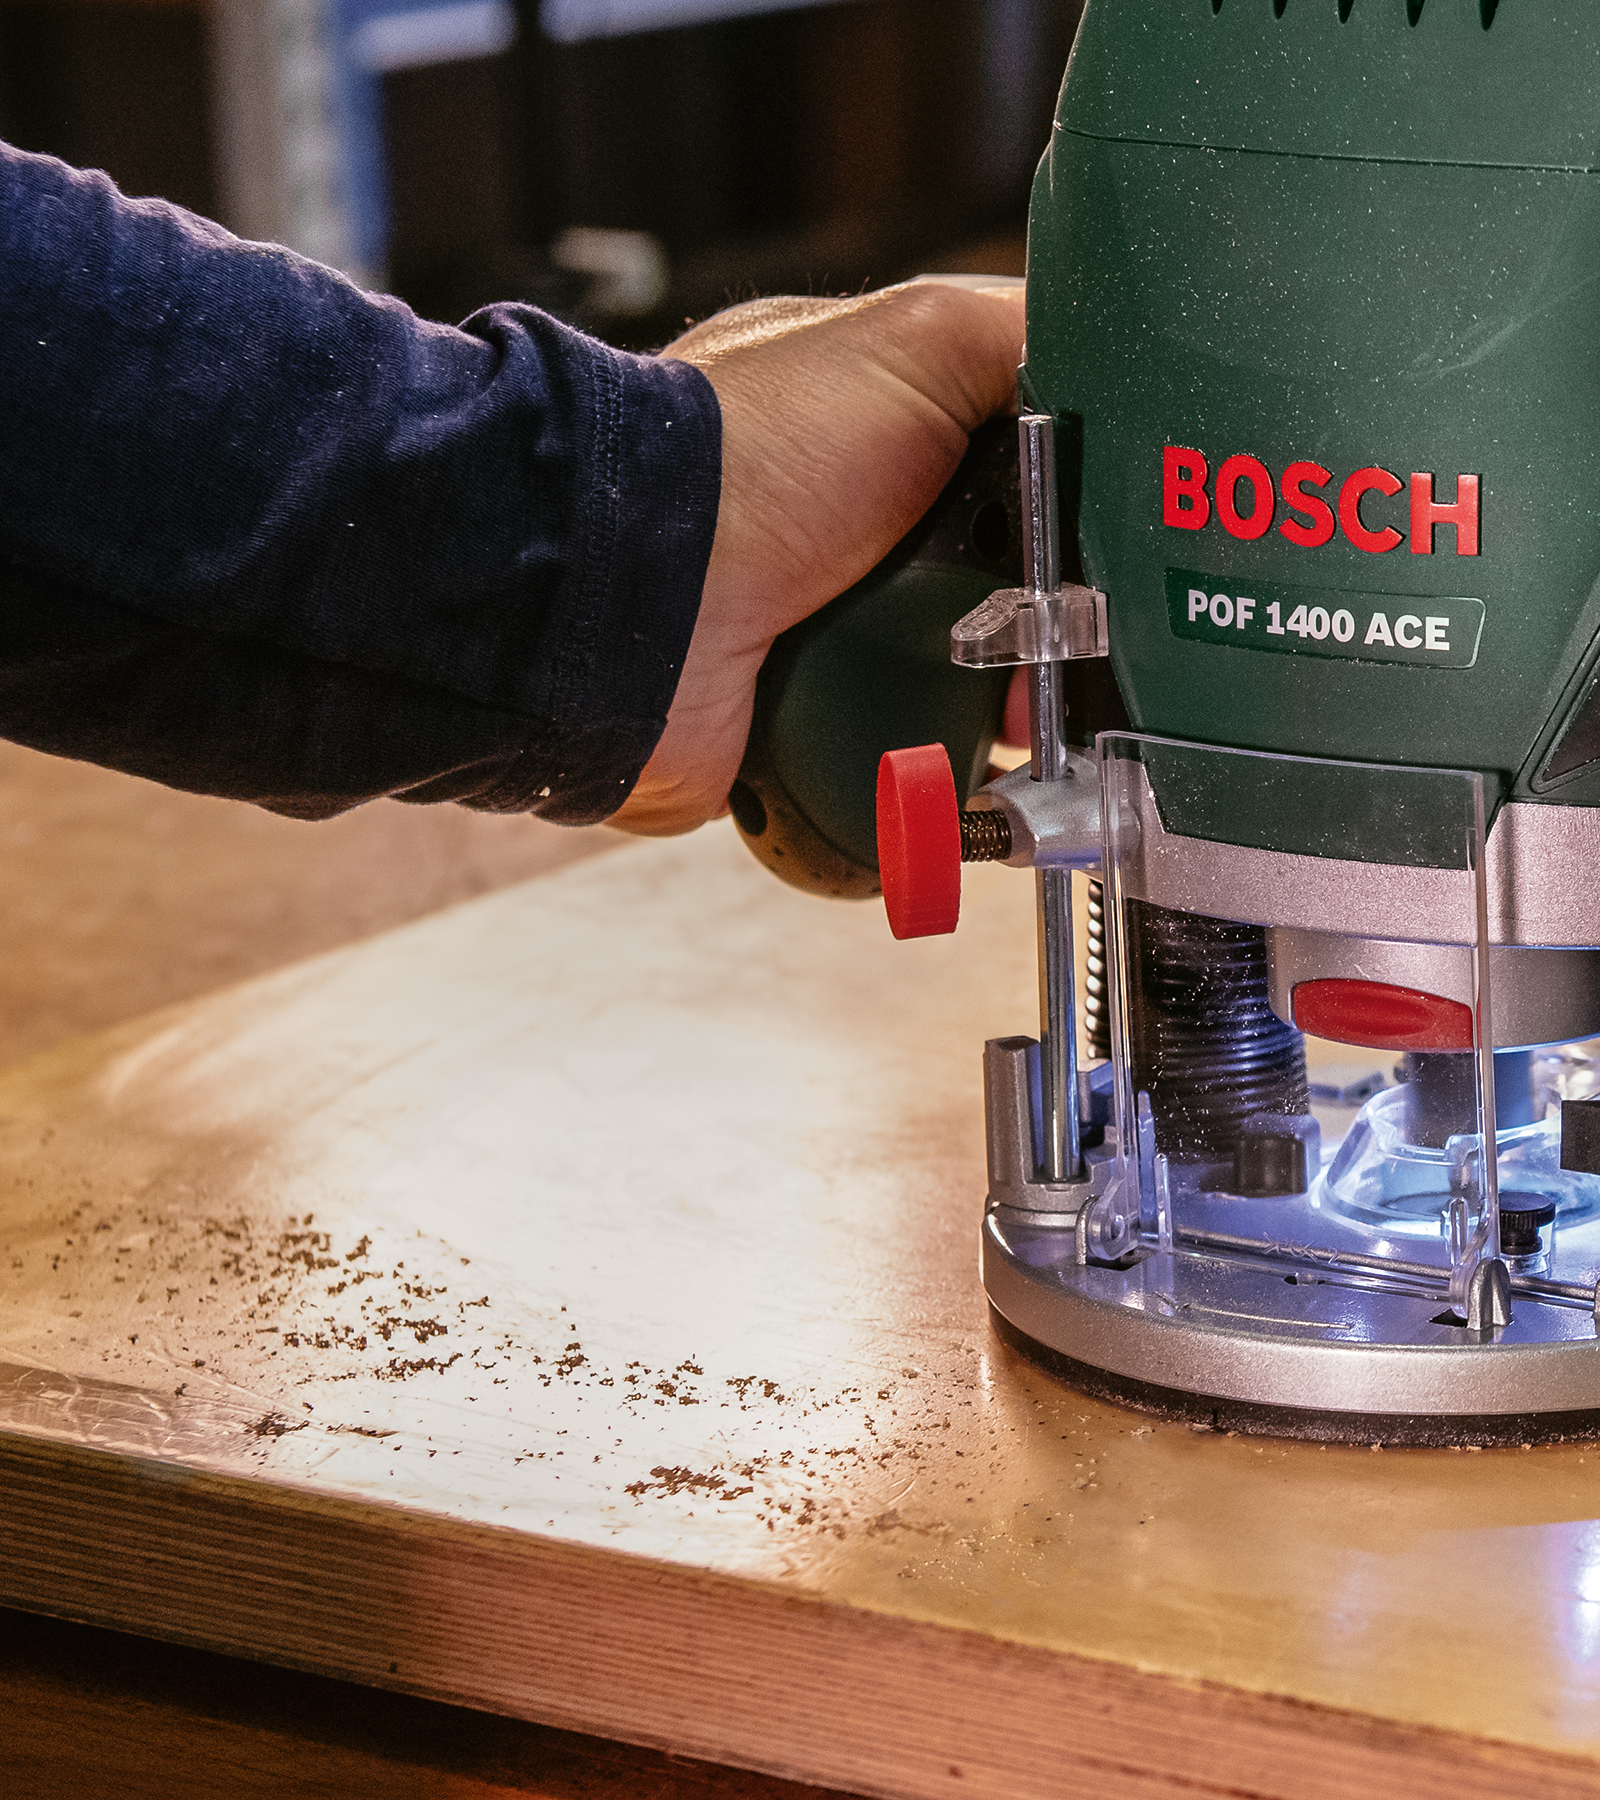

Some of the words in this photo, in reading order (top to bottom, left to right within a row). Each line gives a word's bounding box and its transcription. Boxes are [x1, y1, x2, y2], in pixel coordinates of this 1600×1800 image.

[1163, 446, 1482, 556] BOSCH
[1187, 589, 1256, 630] POF
[1265, 600, 1355, 643] 1400
[1364, 612, 1451, 651] ACE
